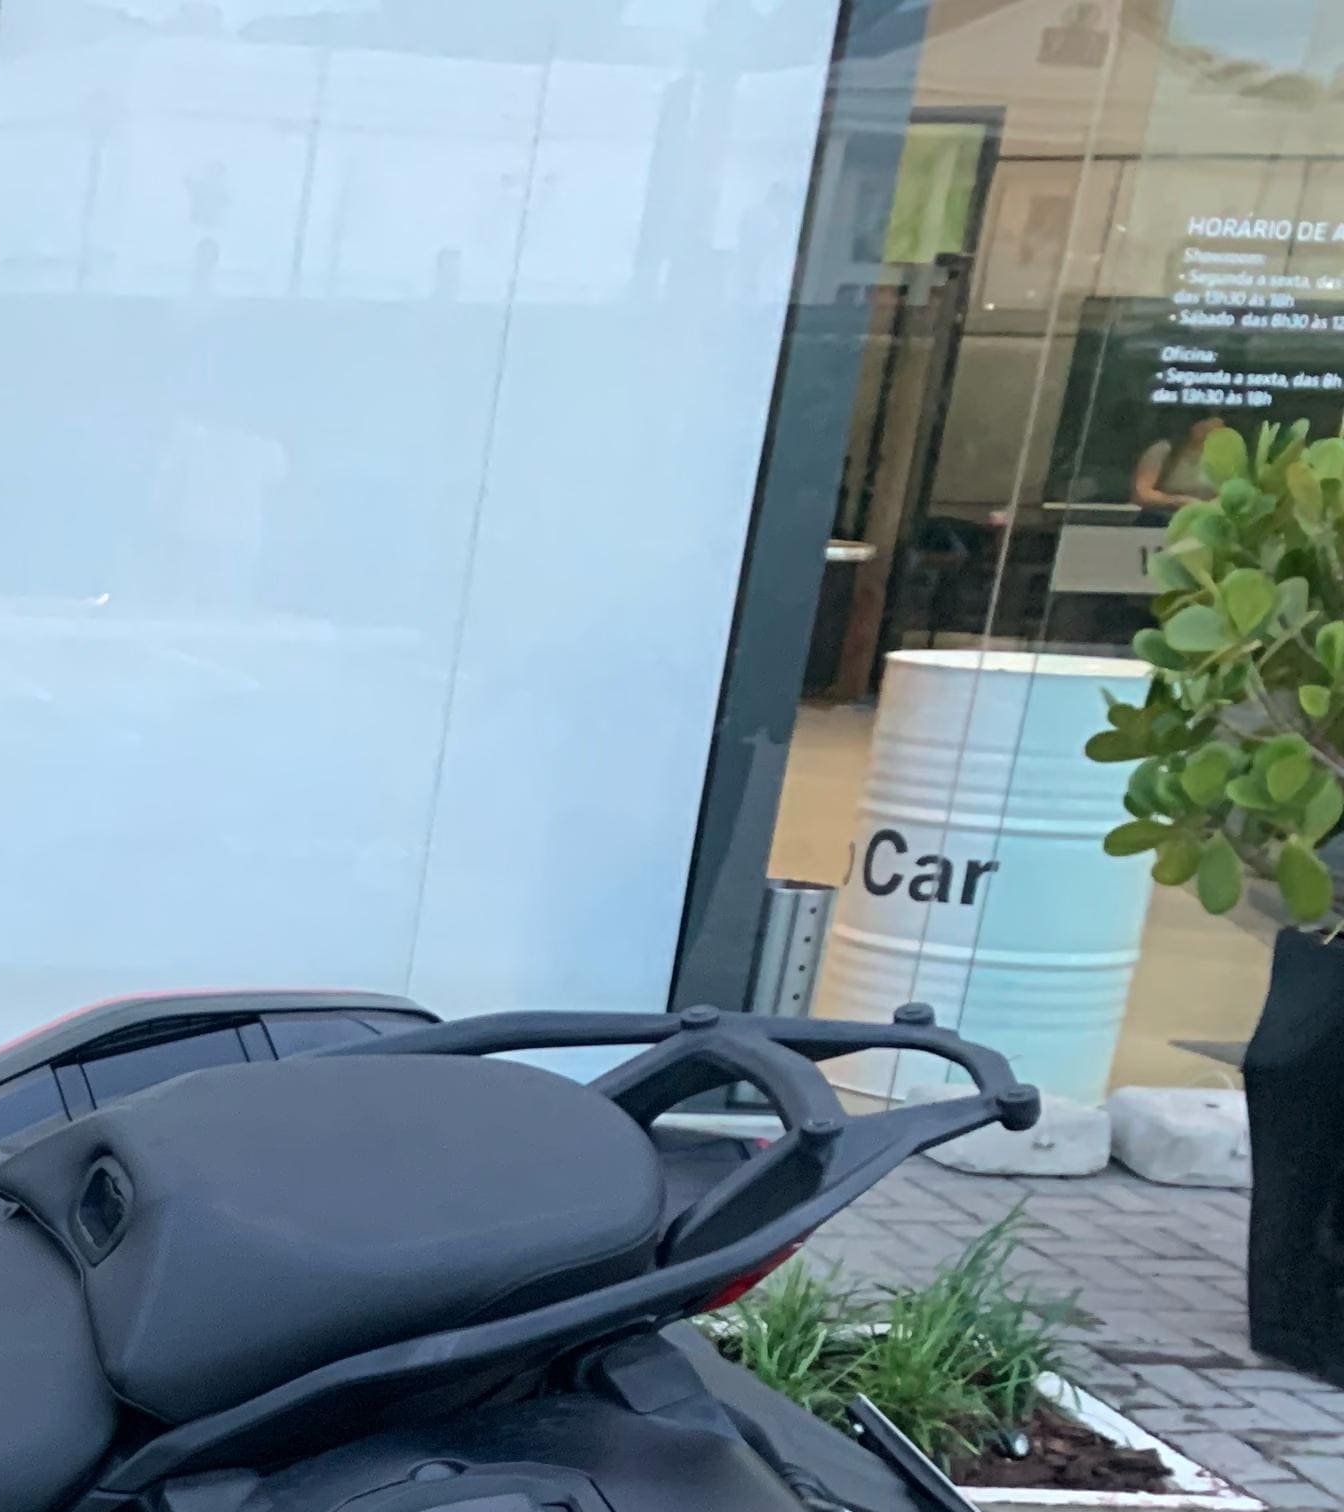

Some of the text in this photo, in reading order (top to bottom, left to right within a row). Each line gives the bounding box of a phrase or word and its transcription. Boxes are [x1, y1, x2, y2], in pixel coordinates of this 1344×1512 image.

[1296, 221, 1328, 241] DE
[1241, 311, 1267, 327] das
[1166, 367, 1231, 386] Segunda
[1233, 373, 1244, 385] a
[1292, 372, 1320, 388] das
